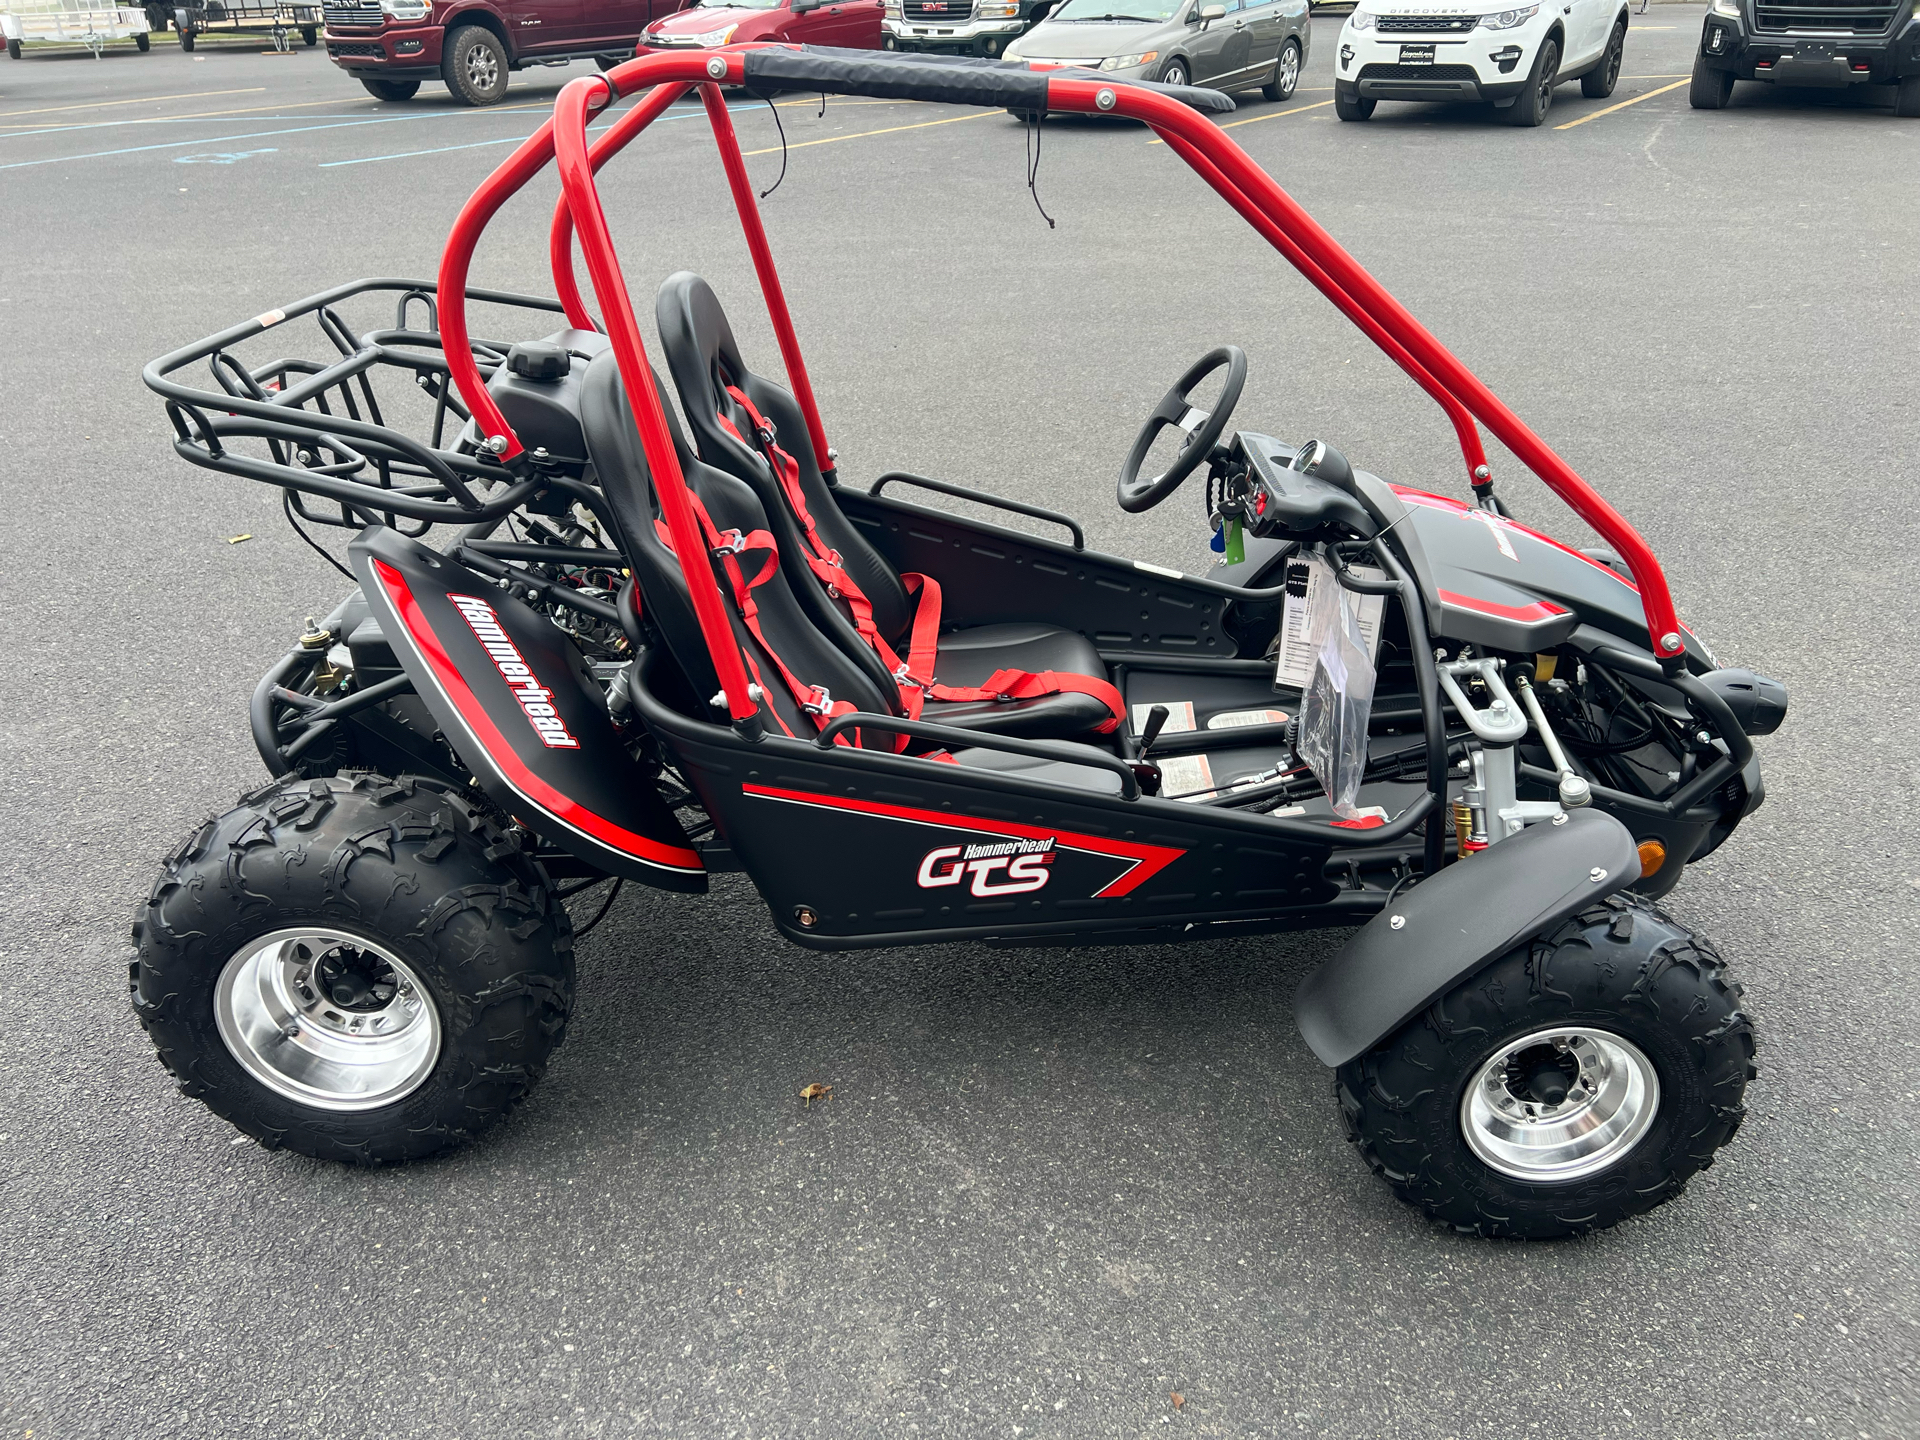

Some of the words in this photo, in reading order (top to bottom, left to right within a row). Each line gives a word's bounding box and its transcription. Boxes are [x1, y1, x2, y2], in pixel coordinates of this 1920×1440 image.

[922, 2, 948, 11] GMC
[448, 594, 580, 748] Hammerhead
[963, 836, 1055, 860] Hammerhead
[917, 845, 1057, 898] GTS
